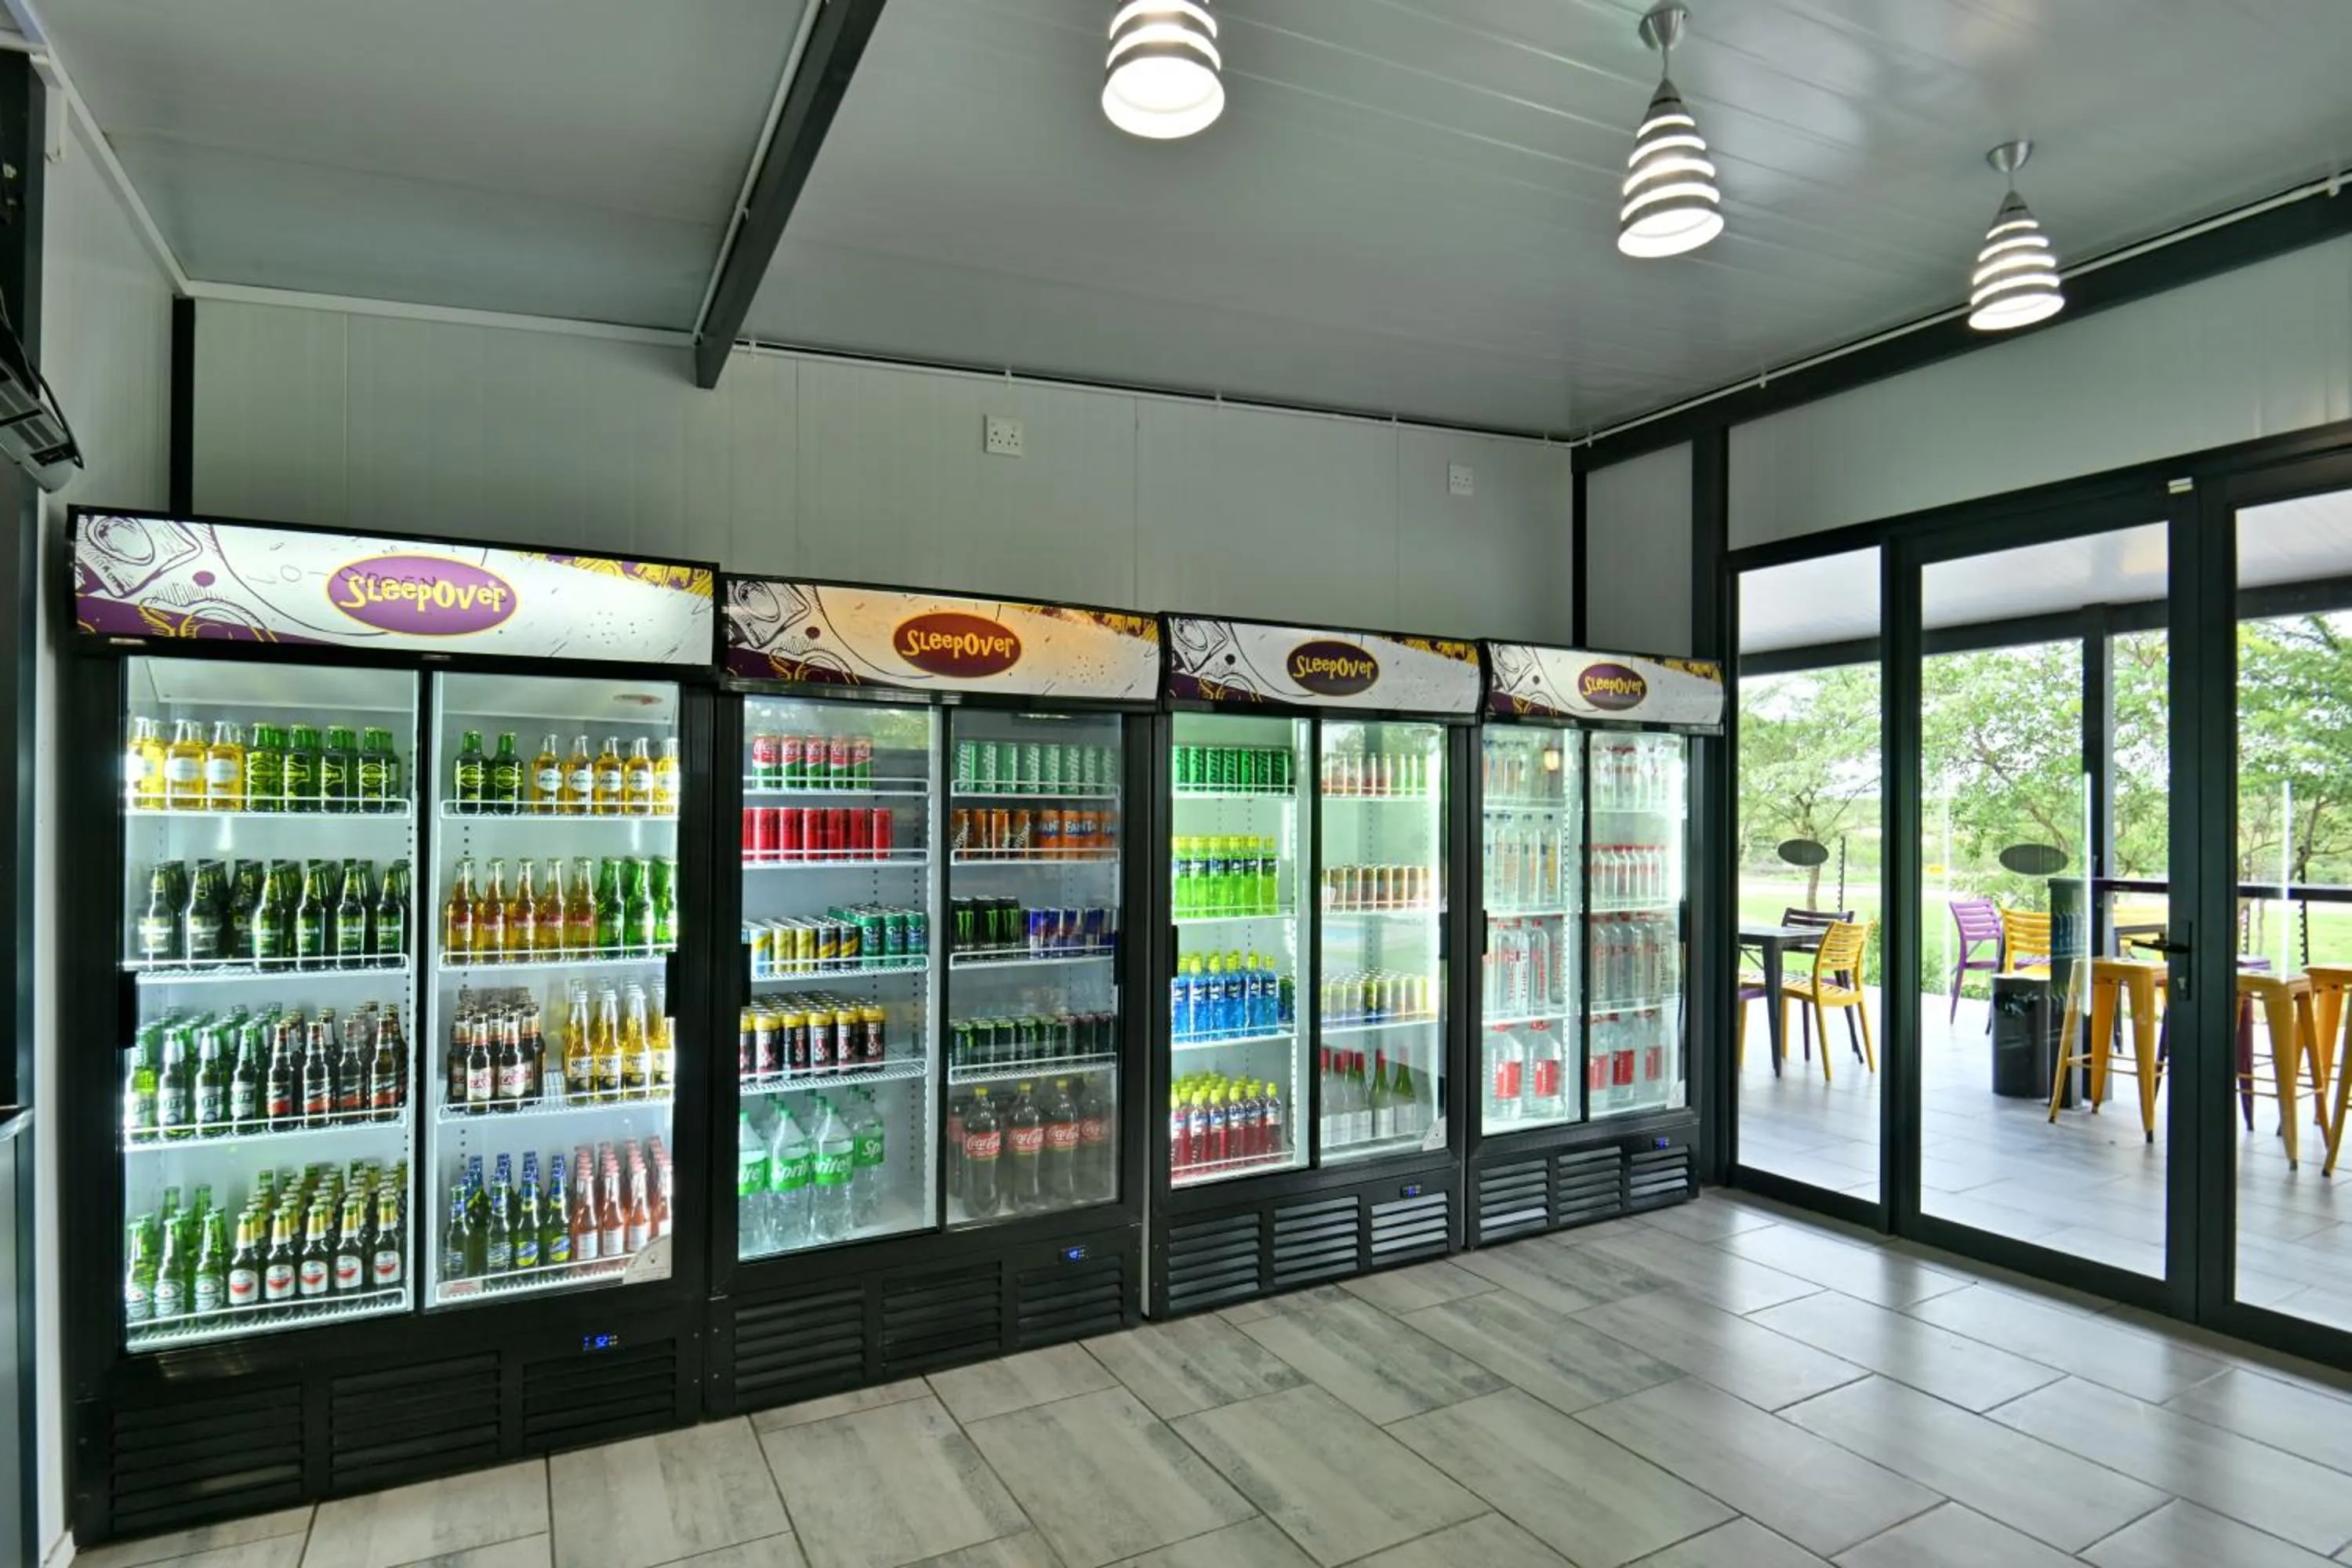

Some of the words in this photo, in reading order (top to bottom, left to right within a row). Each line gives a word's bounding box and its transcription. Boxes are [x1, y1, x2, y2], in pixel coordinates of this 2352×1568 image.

[338, 575, 507, 612] SleepOver
[902, 630, 1014, 659] SleepOver
[1293, 655, 1374, 680] SleepOver
